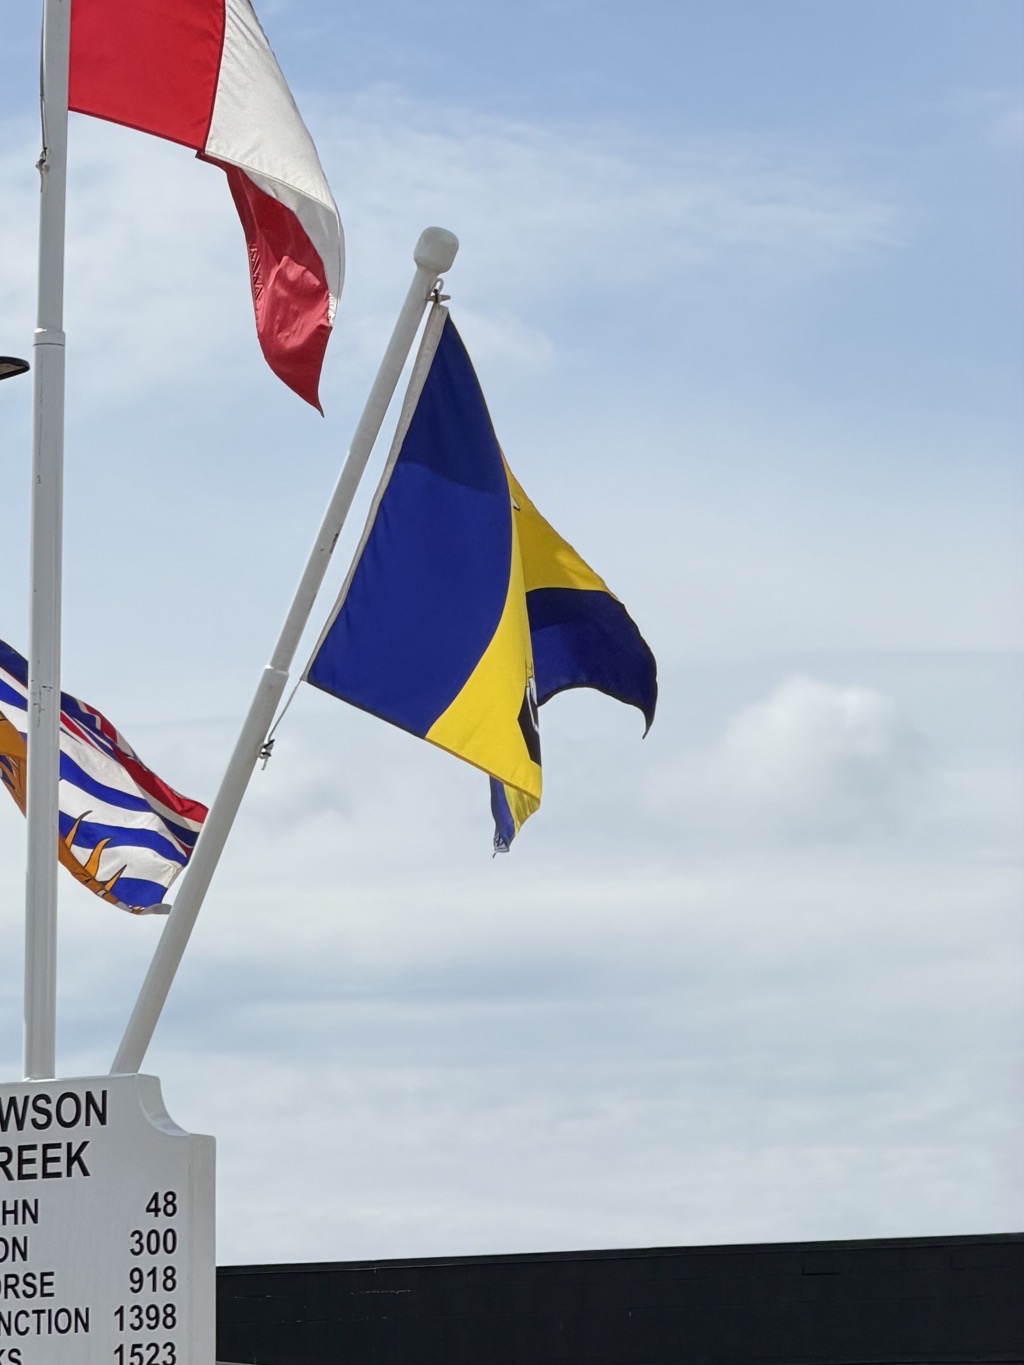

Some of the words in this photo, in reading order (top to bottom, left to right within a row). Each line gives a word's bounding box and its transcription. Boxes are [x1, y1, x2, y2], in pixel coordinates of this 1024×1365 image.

[146, 1191, 177, 1217] 48
[130, 1228, 177, 1256] 300
[130, 1266, 176, 1293] 918
[114, 1304, 176, 1331] 1398
